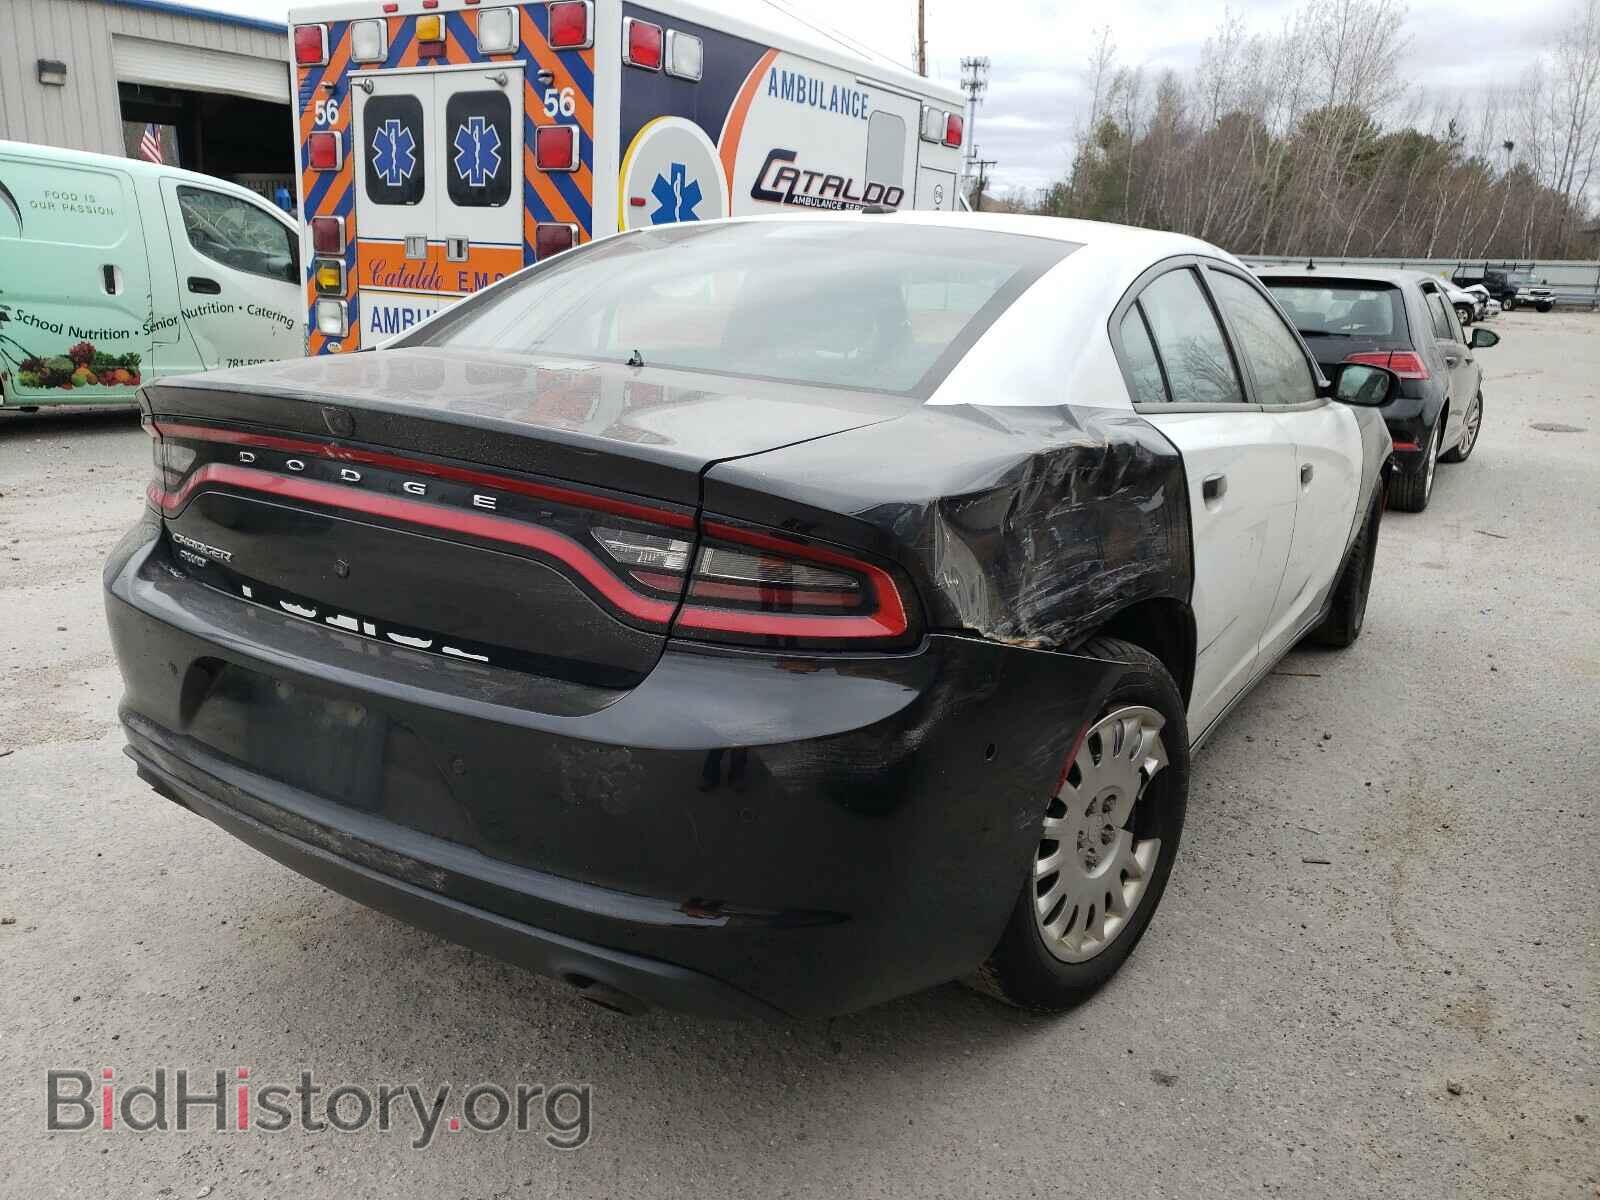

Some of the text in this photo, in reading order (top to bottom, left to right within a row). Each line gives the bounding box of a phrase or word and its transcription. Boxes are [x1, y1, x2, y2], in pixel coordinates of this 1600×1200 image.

[544, 87, 576, 117] 56
[768, 67, 870, 120] AMBULANCE
[315, 99, 339, 126] 56
[750, 148, 905, 207] CATALDO
[30, 200, 114, 216] OUR PASSION
[44, 190, 96, 203] FOOD IS
[792, 195, 841, 210] AMBULANCE
[368, 259, 444, 290] Cataldo
[14, 302, 295, 340] School Nutrition Senior Nutrition Catering
[239, 451, 497, 510] DODGE
